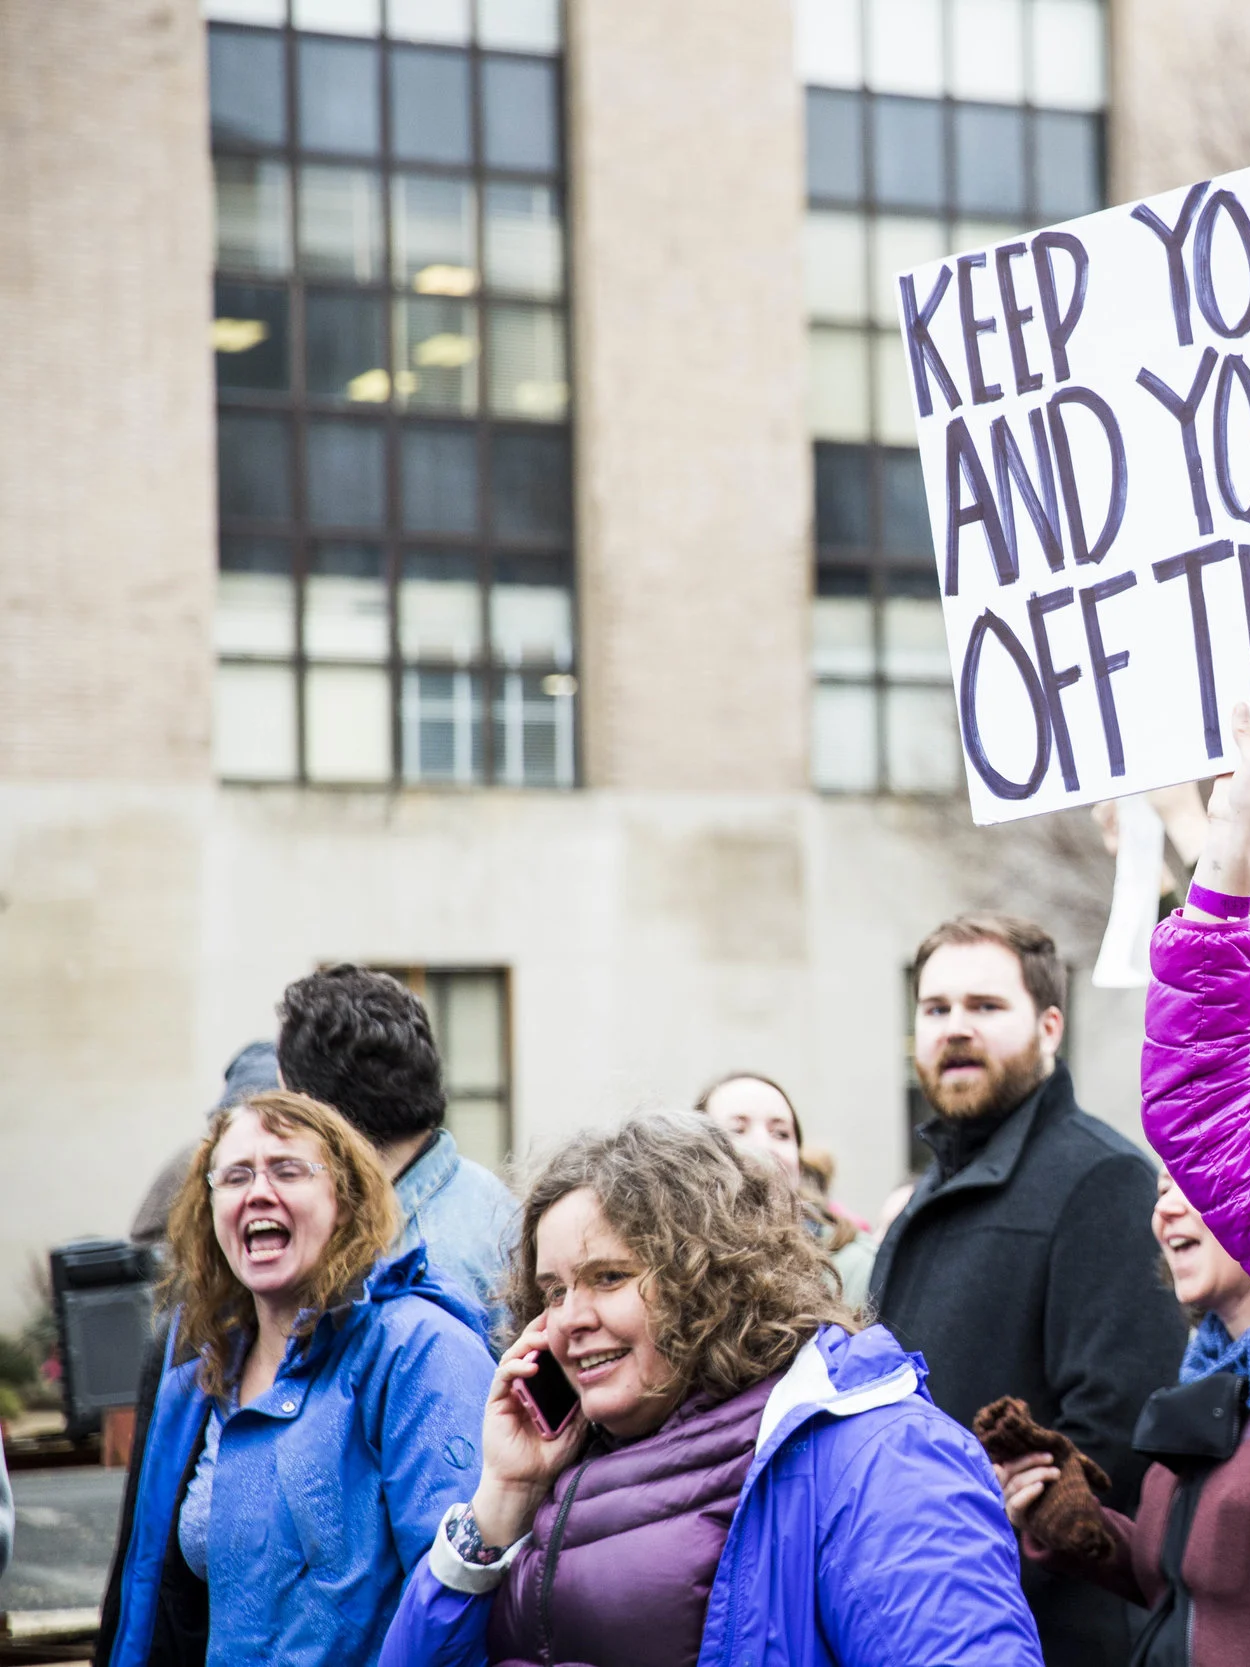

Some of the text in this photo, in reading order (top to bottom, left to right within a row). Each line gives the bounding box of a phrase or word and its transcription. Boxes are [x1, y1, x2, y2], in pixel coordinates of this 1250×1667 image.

[898, 230, 1091, 419] KEEP
[944, 385, 1129, 597] AND
[960, 569, 1138, 800] OFF
